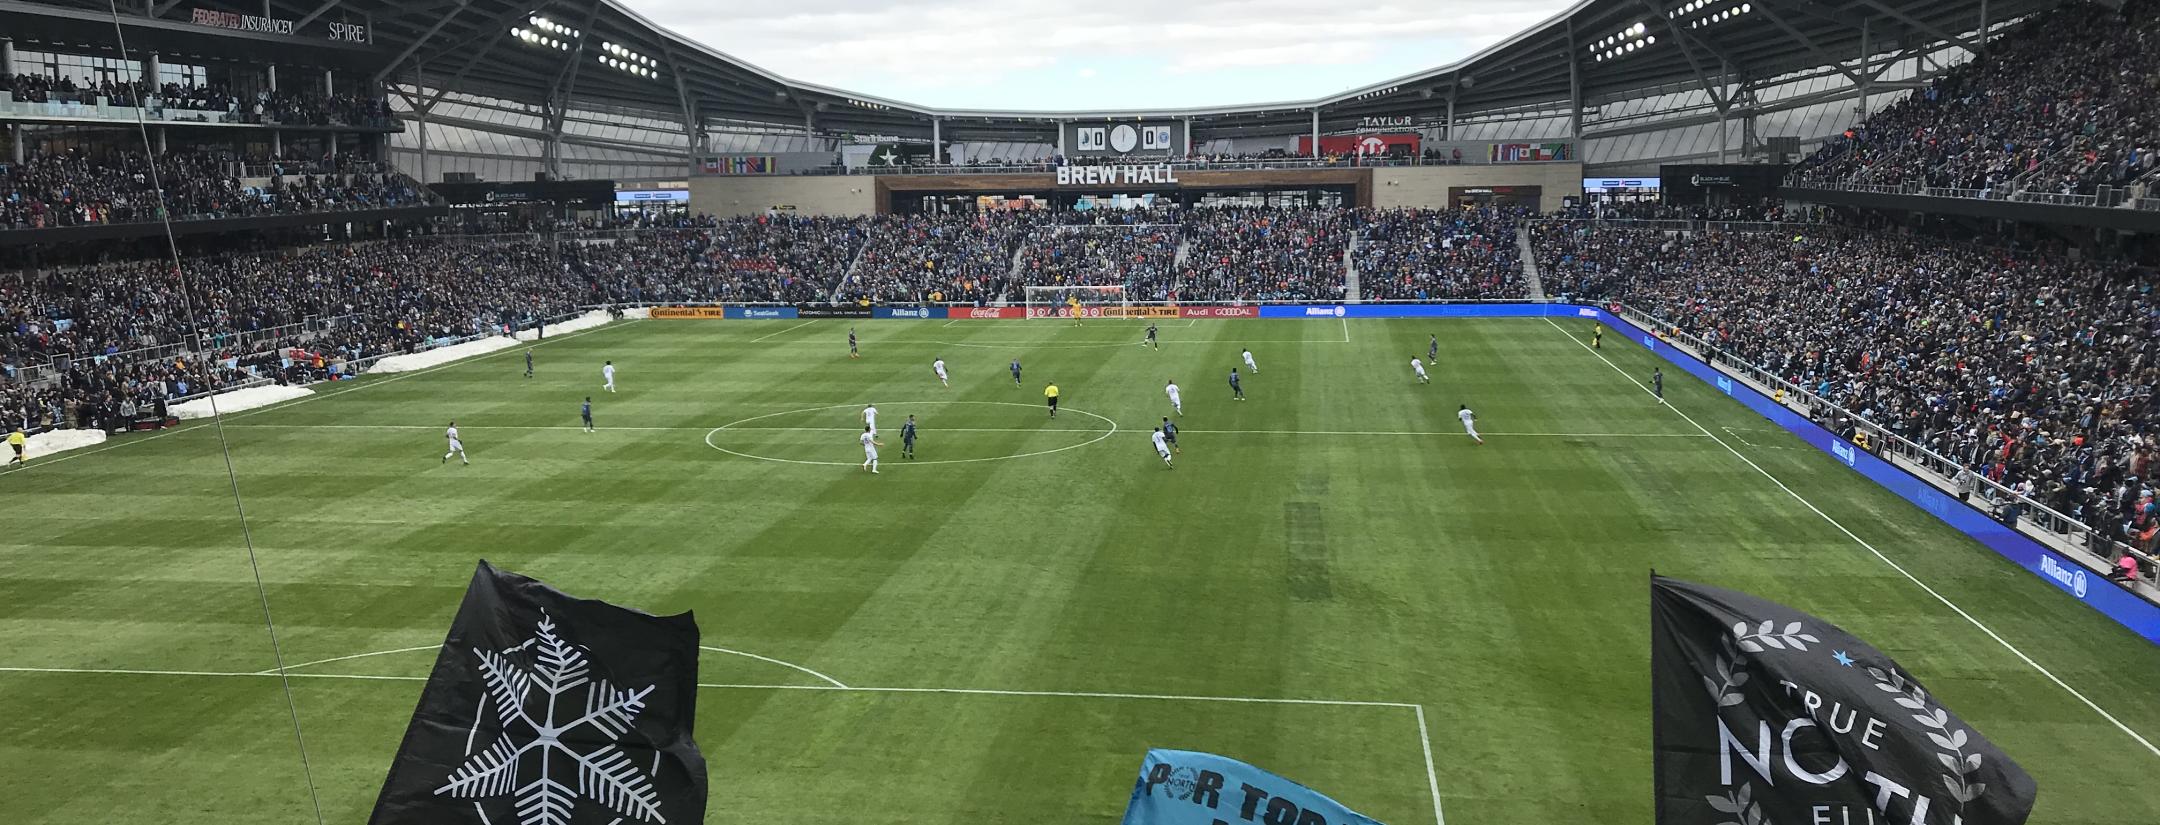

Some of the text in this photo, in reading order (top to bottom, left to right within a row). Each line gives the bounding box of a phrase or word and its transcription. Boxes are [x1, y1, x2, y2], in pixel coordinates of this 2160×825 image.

[193, 8, 288, 34] FEDERATED INSURANCE
[329, 22, 365, 42] SPIRE
[1363, 116, 1411, 126] TAYLOR
[1095, 132, 1102, 145] 0
[1146, 131, 1153, 144] 0
[1057, 165, 1178, 184] BREW HALL
[651, 307, 699, 317] Continental
[1103, 308, 1150, 317] Continental
[2041, 554, 2073, 587] Allianz
[1780, 680, 1887, 750] TRUE
